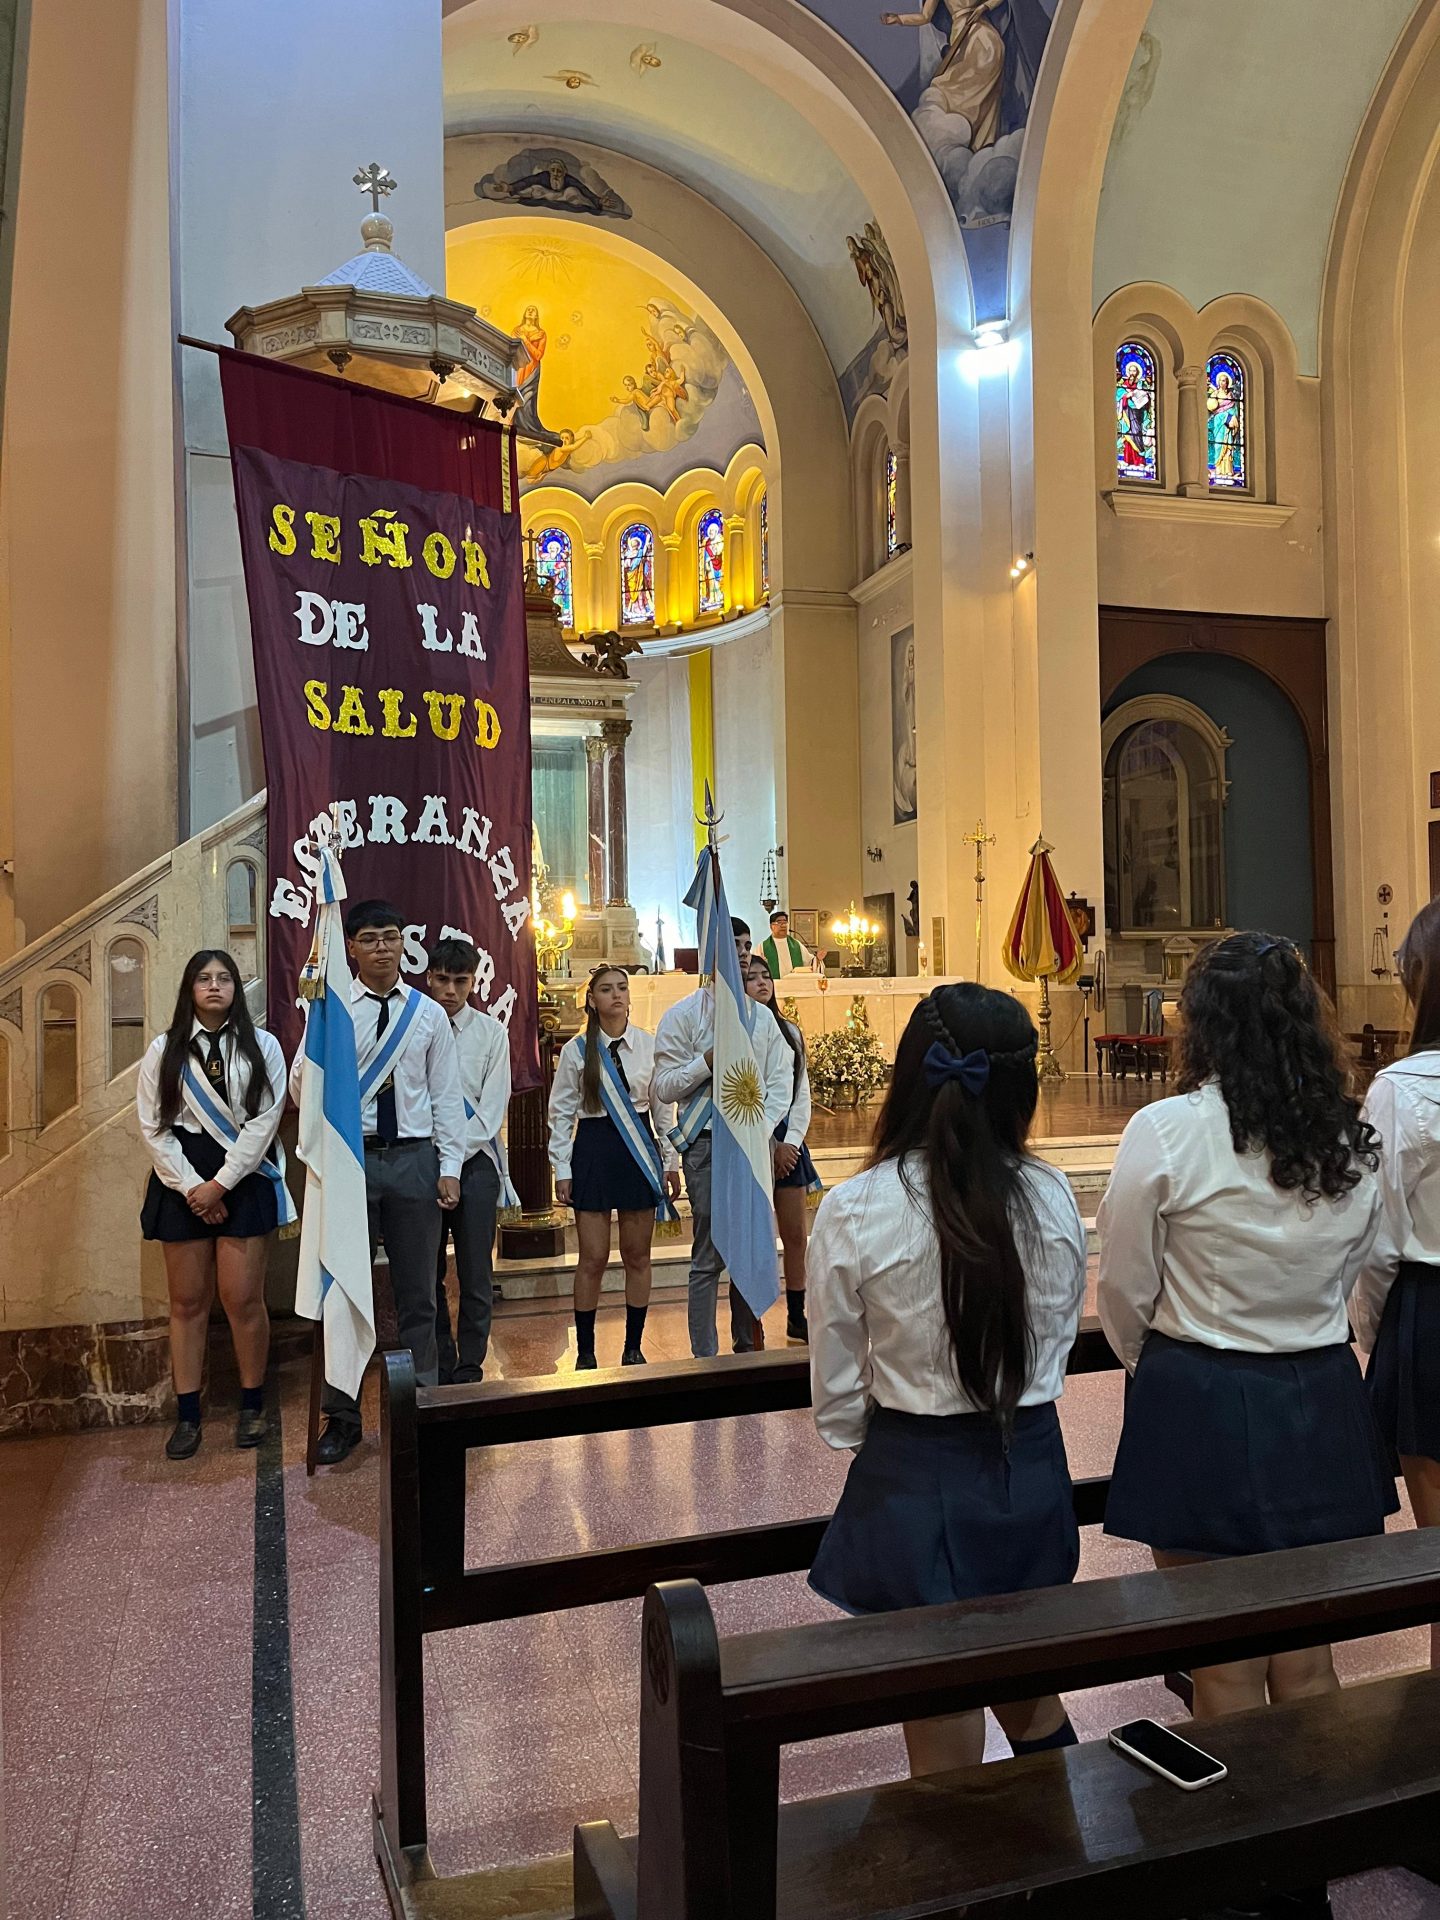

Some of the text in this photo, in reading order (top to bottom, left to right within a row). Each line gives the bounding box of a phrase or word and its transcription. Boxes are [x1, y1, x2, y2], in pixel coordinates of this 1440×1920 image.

[269, 504, 491, 590] SEÑOR
[293, 591, 487, 662] DE LA
[303, 680, 502, 750] SALUD
[269, 794, 530, 942] ESPERANZA
